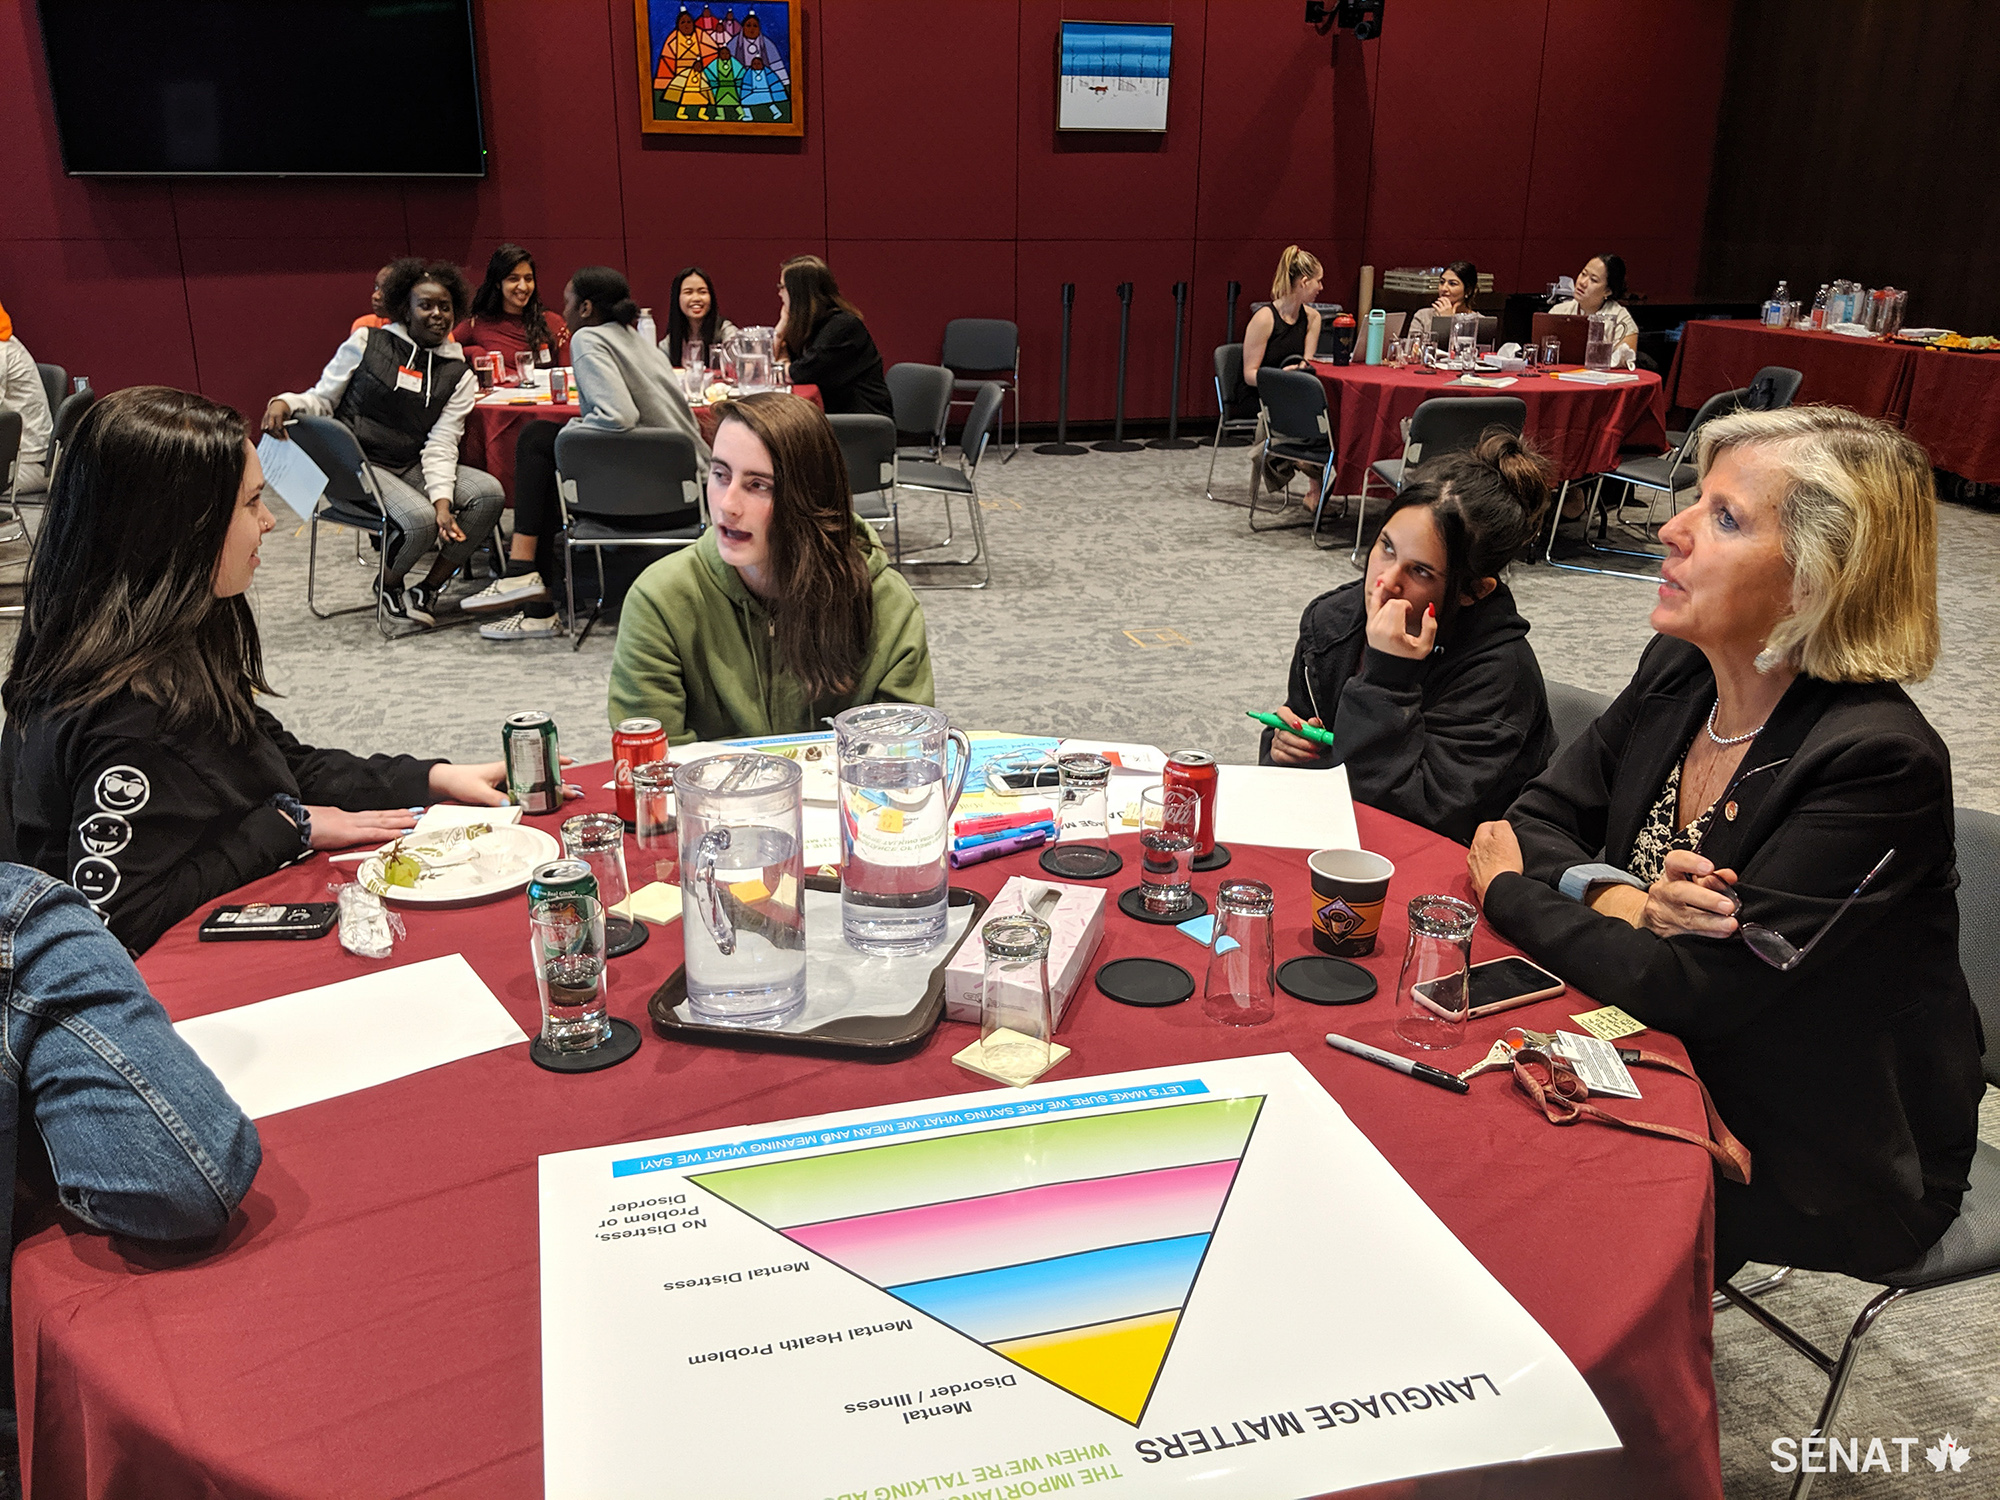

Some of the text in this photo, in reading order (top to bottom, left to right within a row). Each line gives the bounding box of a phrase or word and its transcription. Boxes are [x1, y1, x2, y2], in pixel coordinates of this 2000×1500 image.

[640, 1084, 1186, 1170] LET'S MAKE SURE WE ARE SAYING WHAT WE MEAN AND MEANING WHAT WE SAY!
[609, 1194, 686, 1214] Disorder
[598, 1206, 699, 1229] Problem or
[595, 1219, 707, 1243] No Distress,
[663, 1261, 810, 1291] Mental Distress
[688, 1319, 913, 1365] Mental Health Problem
[929, 1374, 1017, 1401] Disorder
[844, 1392, 912, 1414] Illness
[902, 1400, 972, 1424] Mental
[1134, 1373, 1501, 1463] LANGUAGE MATTERS
[1045, 1443, 1111, 1468] WHEN
[971, 1456, 1043, 1482] WE'RE
[1078, 1463, 1123, 1485] THE
[873, 1469, 969, 1500] TALKING
